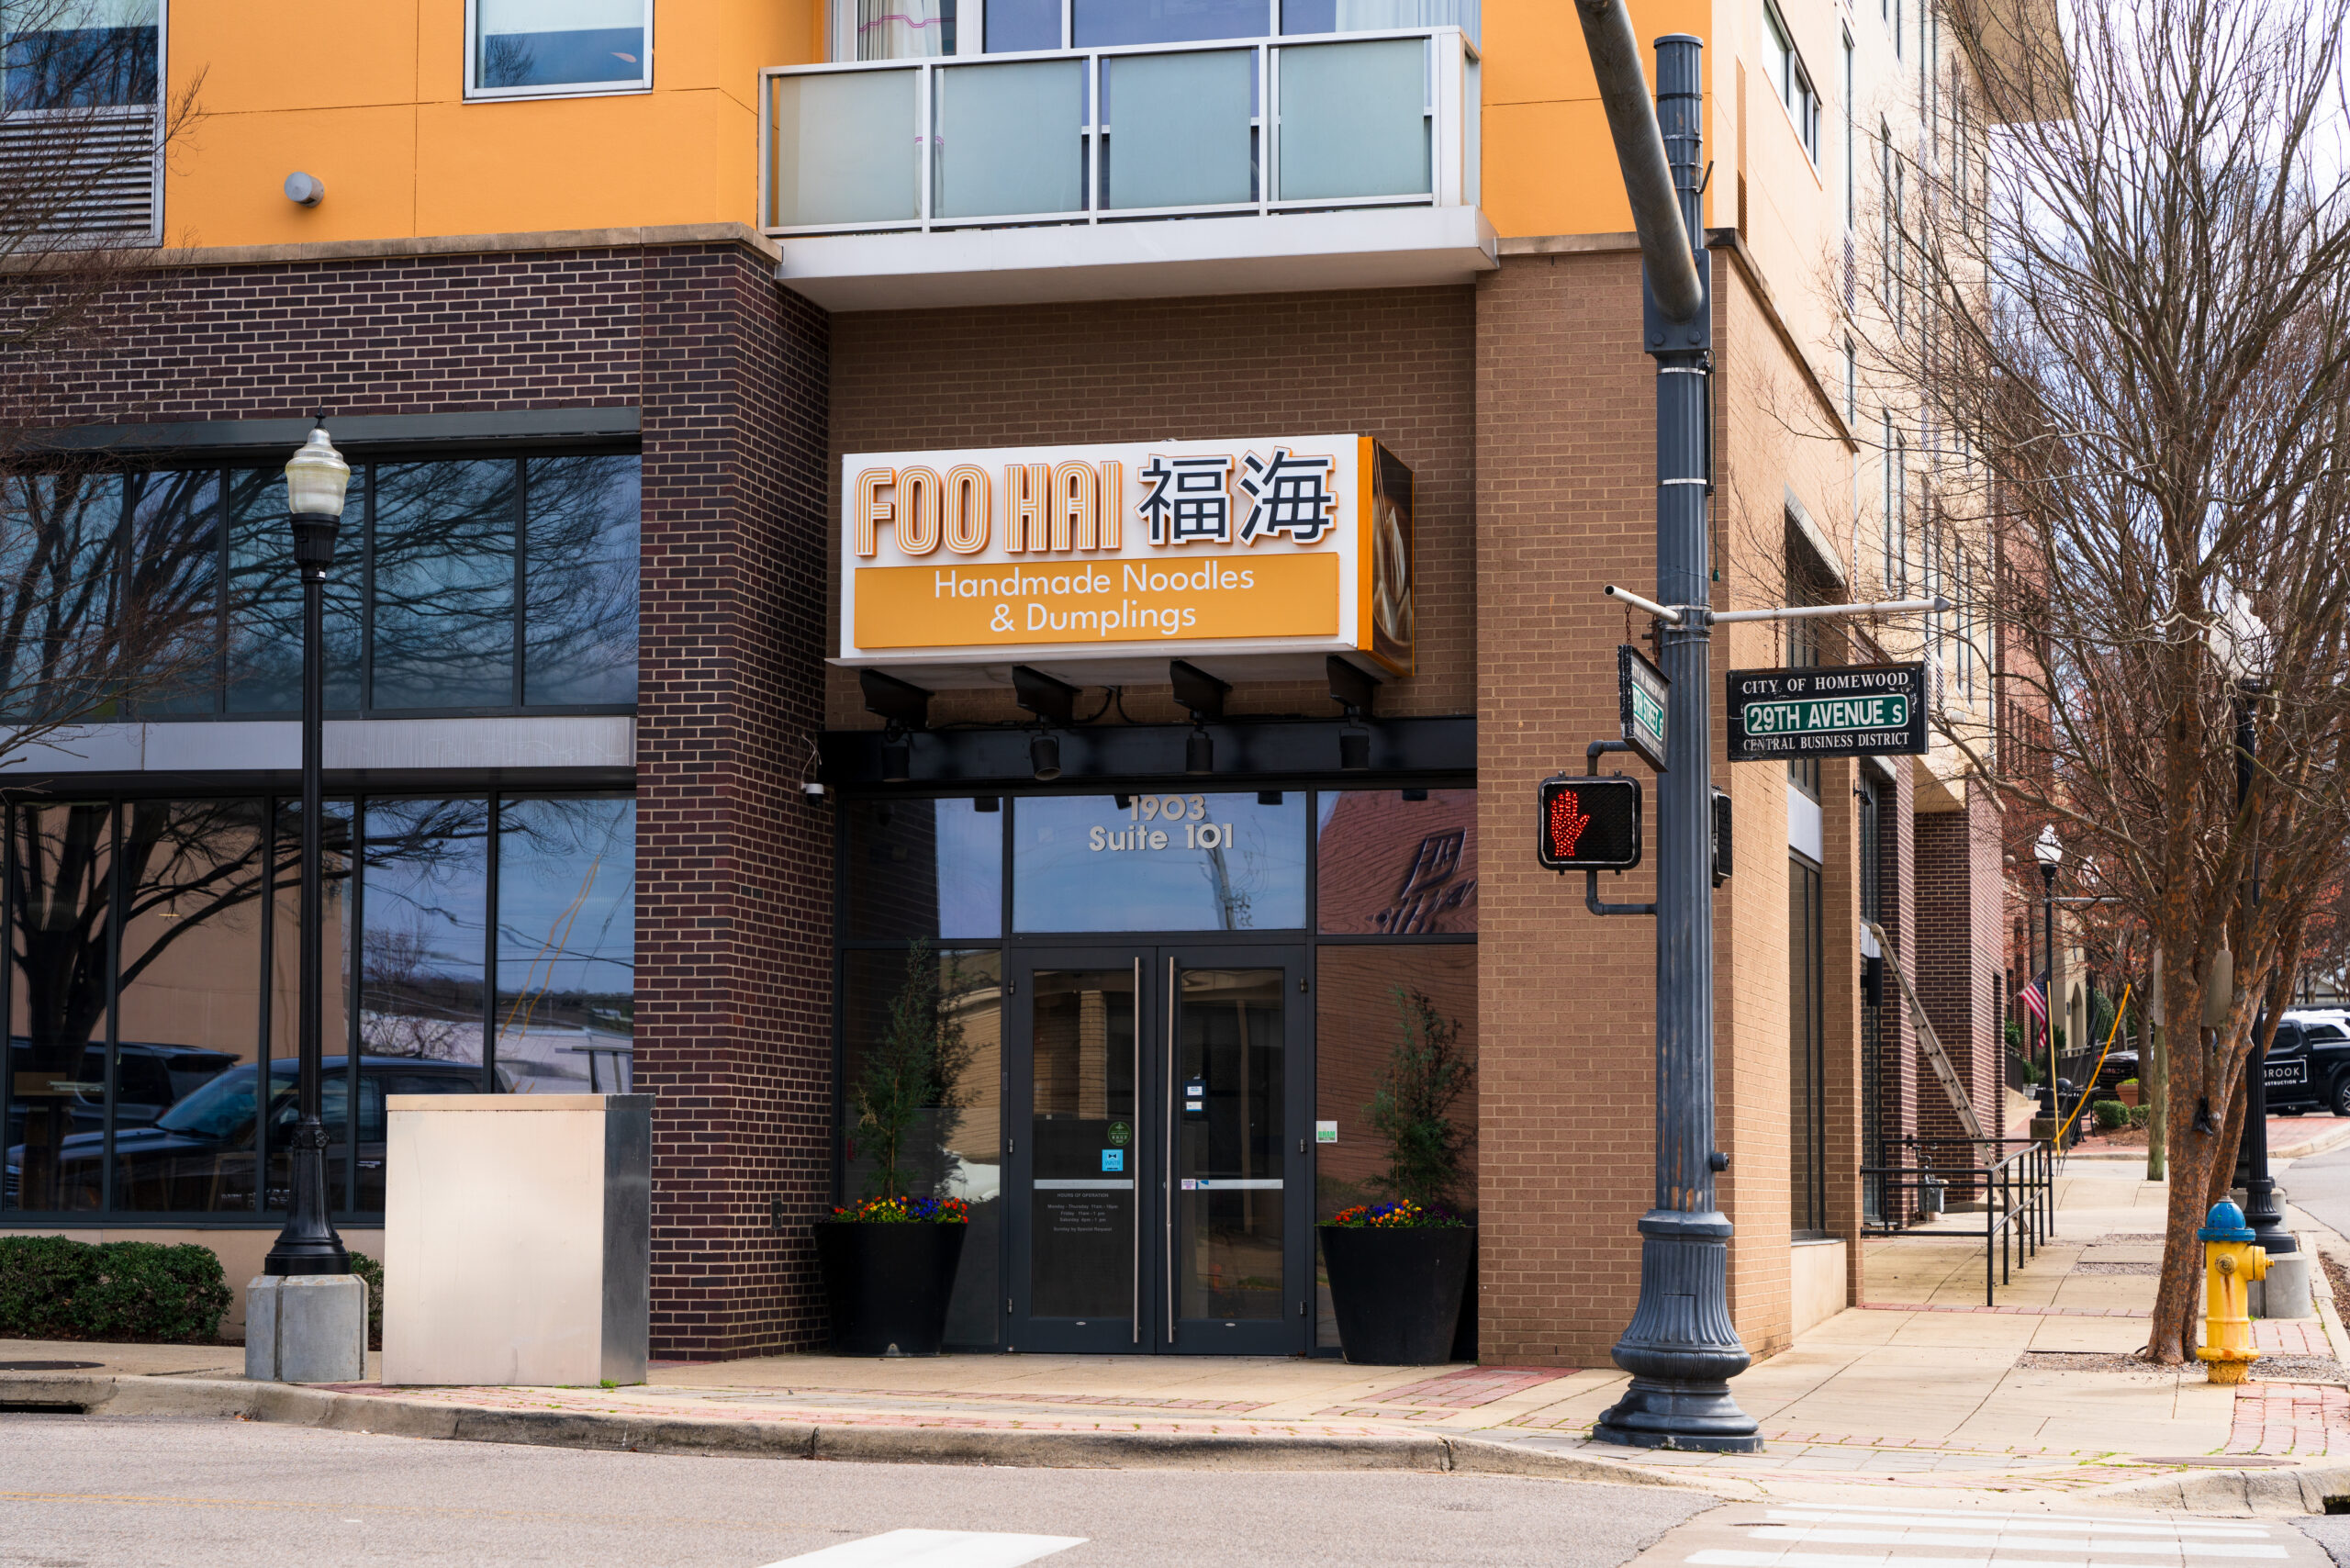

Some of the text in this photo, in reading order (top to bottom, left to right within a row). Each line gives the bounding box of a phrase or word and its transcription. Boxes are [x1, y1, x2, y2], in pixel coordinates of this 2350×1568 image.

[855, 461, 1122, 556] FOO HAI
[1136, 448, 1335, 544] 福海
[934, 561, 1255, 599] Handmade Noodles
[990, 600, 1196, 637] & Dumplings
[1742, 672, 1909, 694] CITY OF HOMEWOOD
[1750, 700, 1902, 732] 29TH AVENUE S
[1744, 732, 1909, 752] CENTRAL BUSINESS DISTRICT
[1128, 794, 1206, 822] 1903
[1089, 823, 1234, 852] Suite 101
